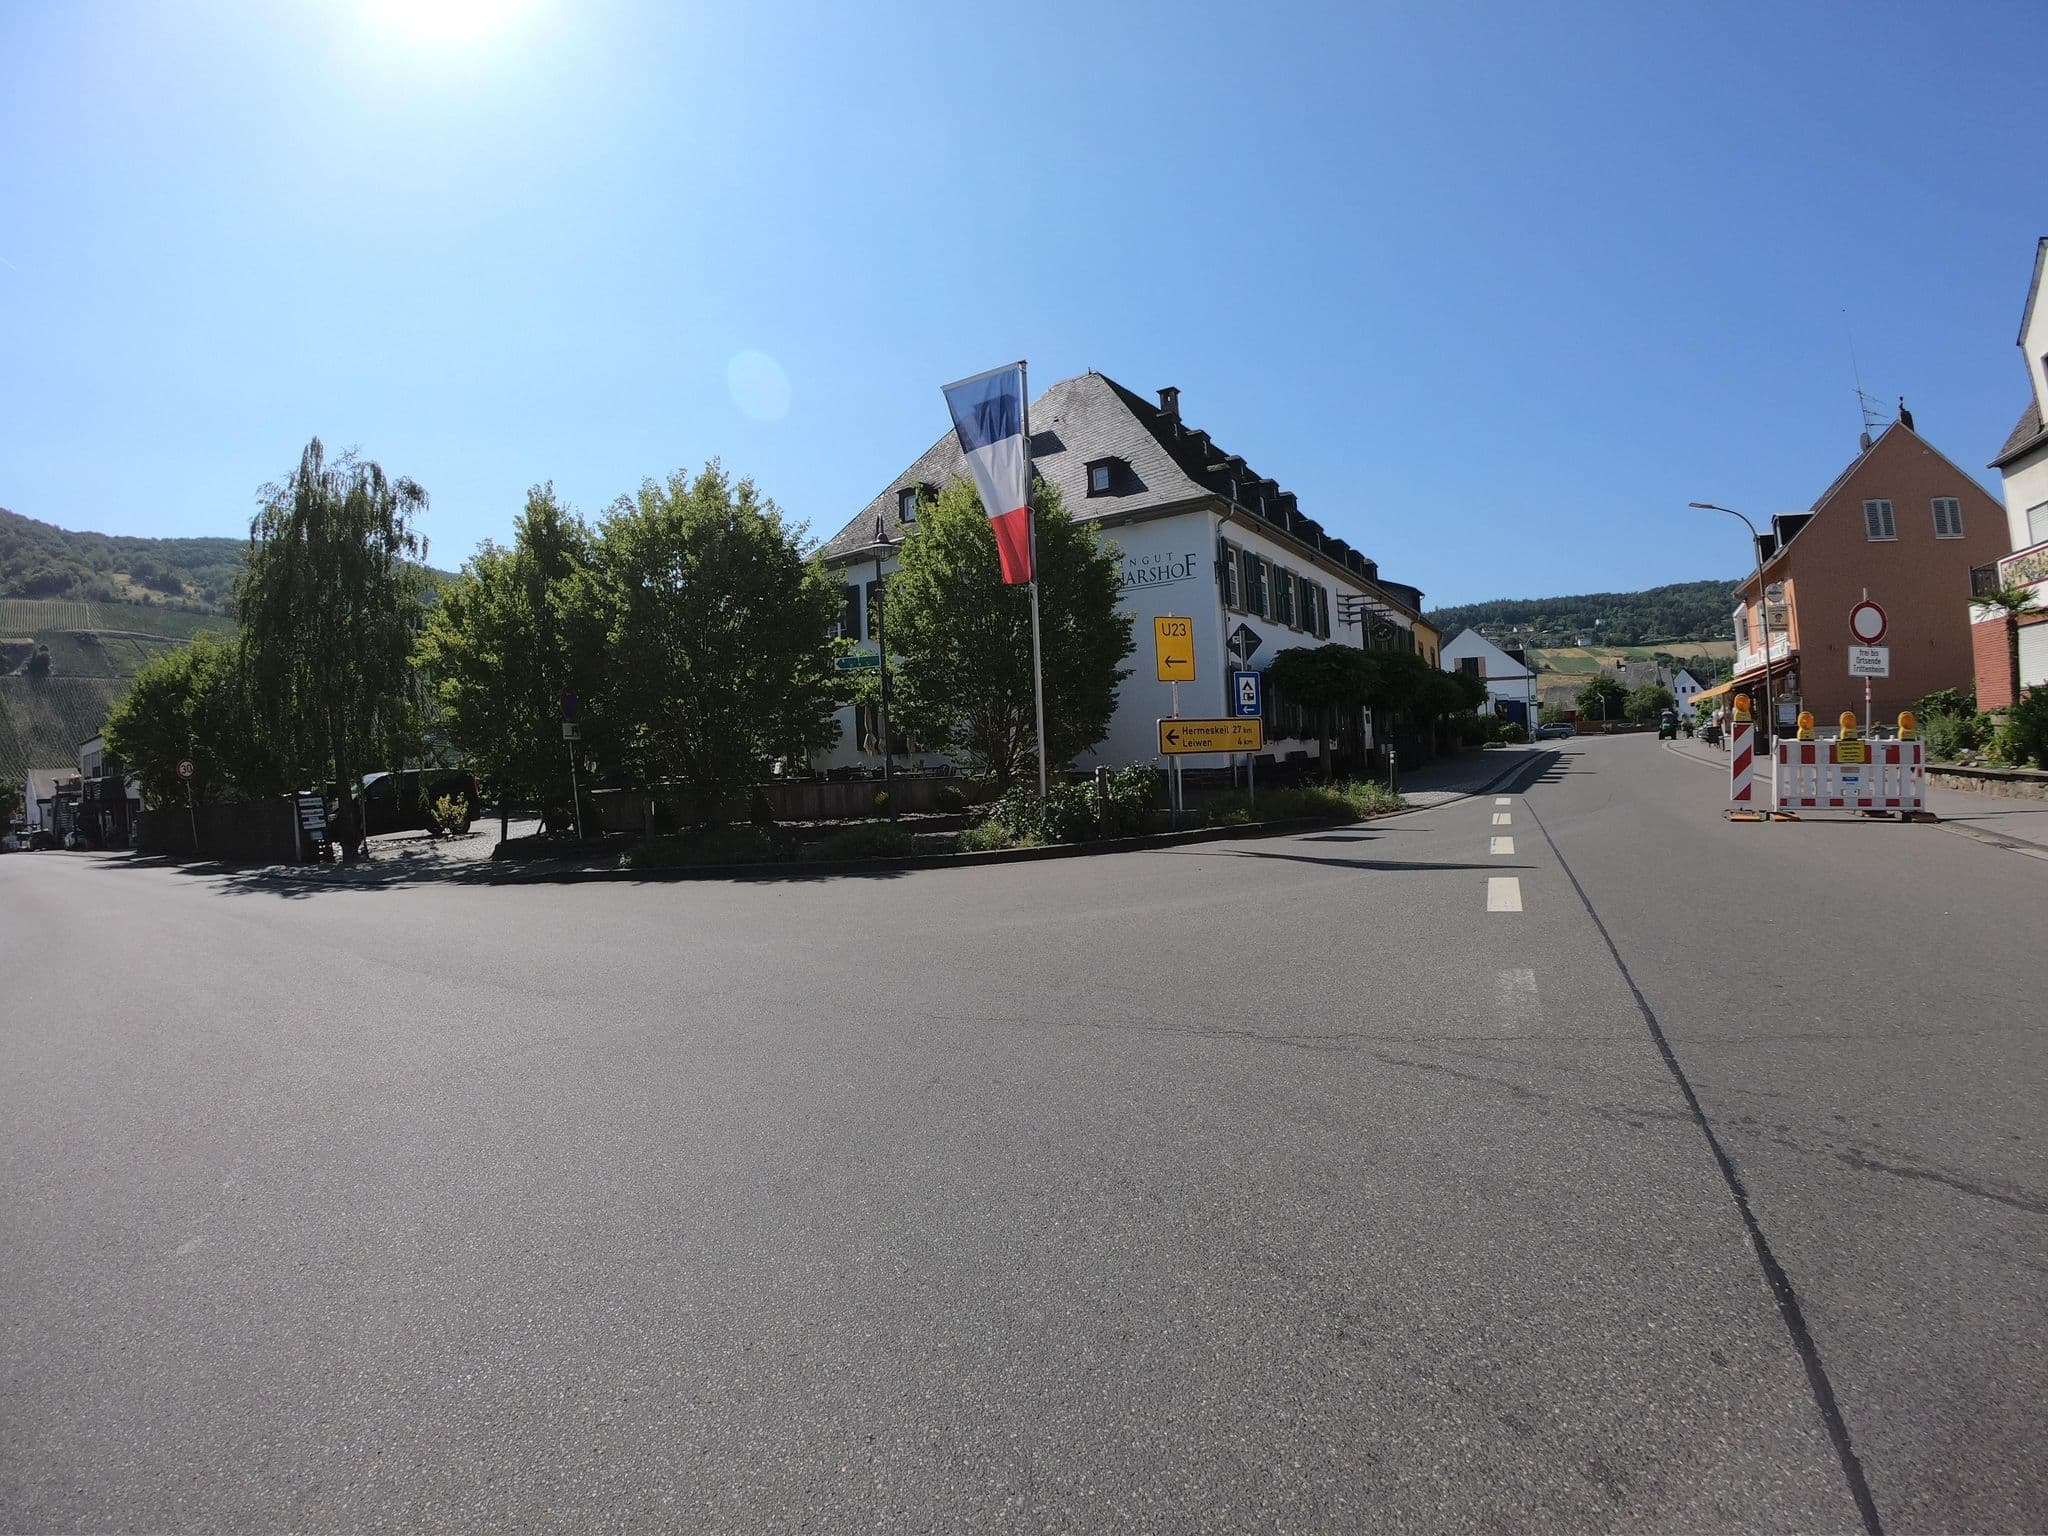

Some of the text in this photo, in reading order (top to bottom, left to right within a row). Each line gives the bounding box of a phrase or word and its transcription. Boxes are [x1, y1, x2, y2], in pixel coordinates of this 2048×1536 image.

[1119, 551, 1173, 569] INGUT
[1161, 622, 1187, 637] U23
[1871, 648, 1879, 656] bis
[1182, 725, 1252, 735] Hermeskeil 27 km
[1182, 738, 1212, 747] Leiwen
[181, 764, 192, 774] 30
